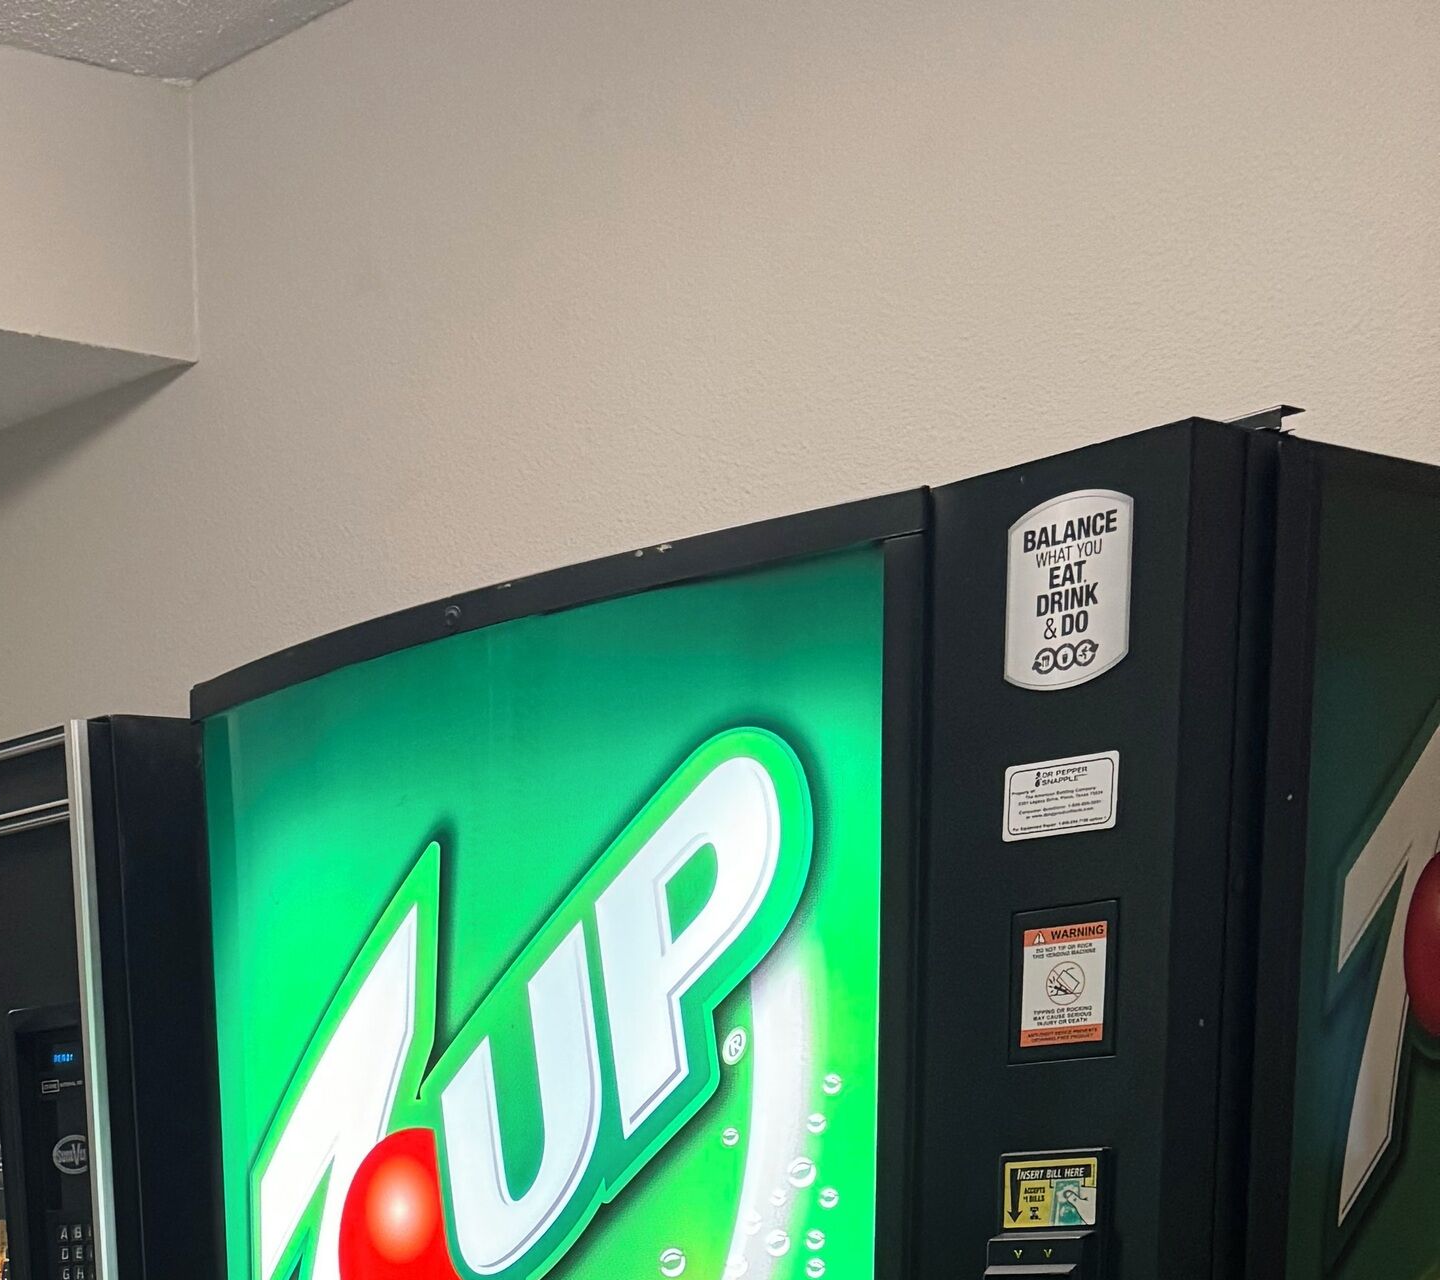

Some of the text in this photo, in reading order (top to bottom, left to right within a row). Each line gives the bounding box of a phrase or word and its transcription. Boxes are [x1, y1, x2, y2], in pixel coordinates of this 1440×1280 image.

[1024, 509, 1117, 553] BALANCE
[1036, 538, 1102, 568] WHAT YOU
[1036, 582, 1098, 617] DRINK
[1043, 610, 1088, 639] & DO
[1056, 766, 1088, 776] PEPPER
[1042, 775, 1078, 786] SNAPPLE
[1051, 925, 1104, 940] WARNING
[1017, 1167, 1084, 1180] INSERT BILL HERE
[60, 1227, 82, 1240] A B
[62, 1248, 82, 1260] D E
[63, 1268, 84, 1280] G H
